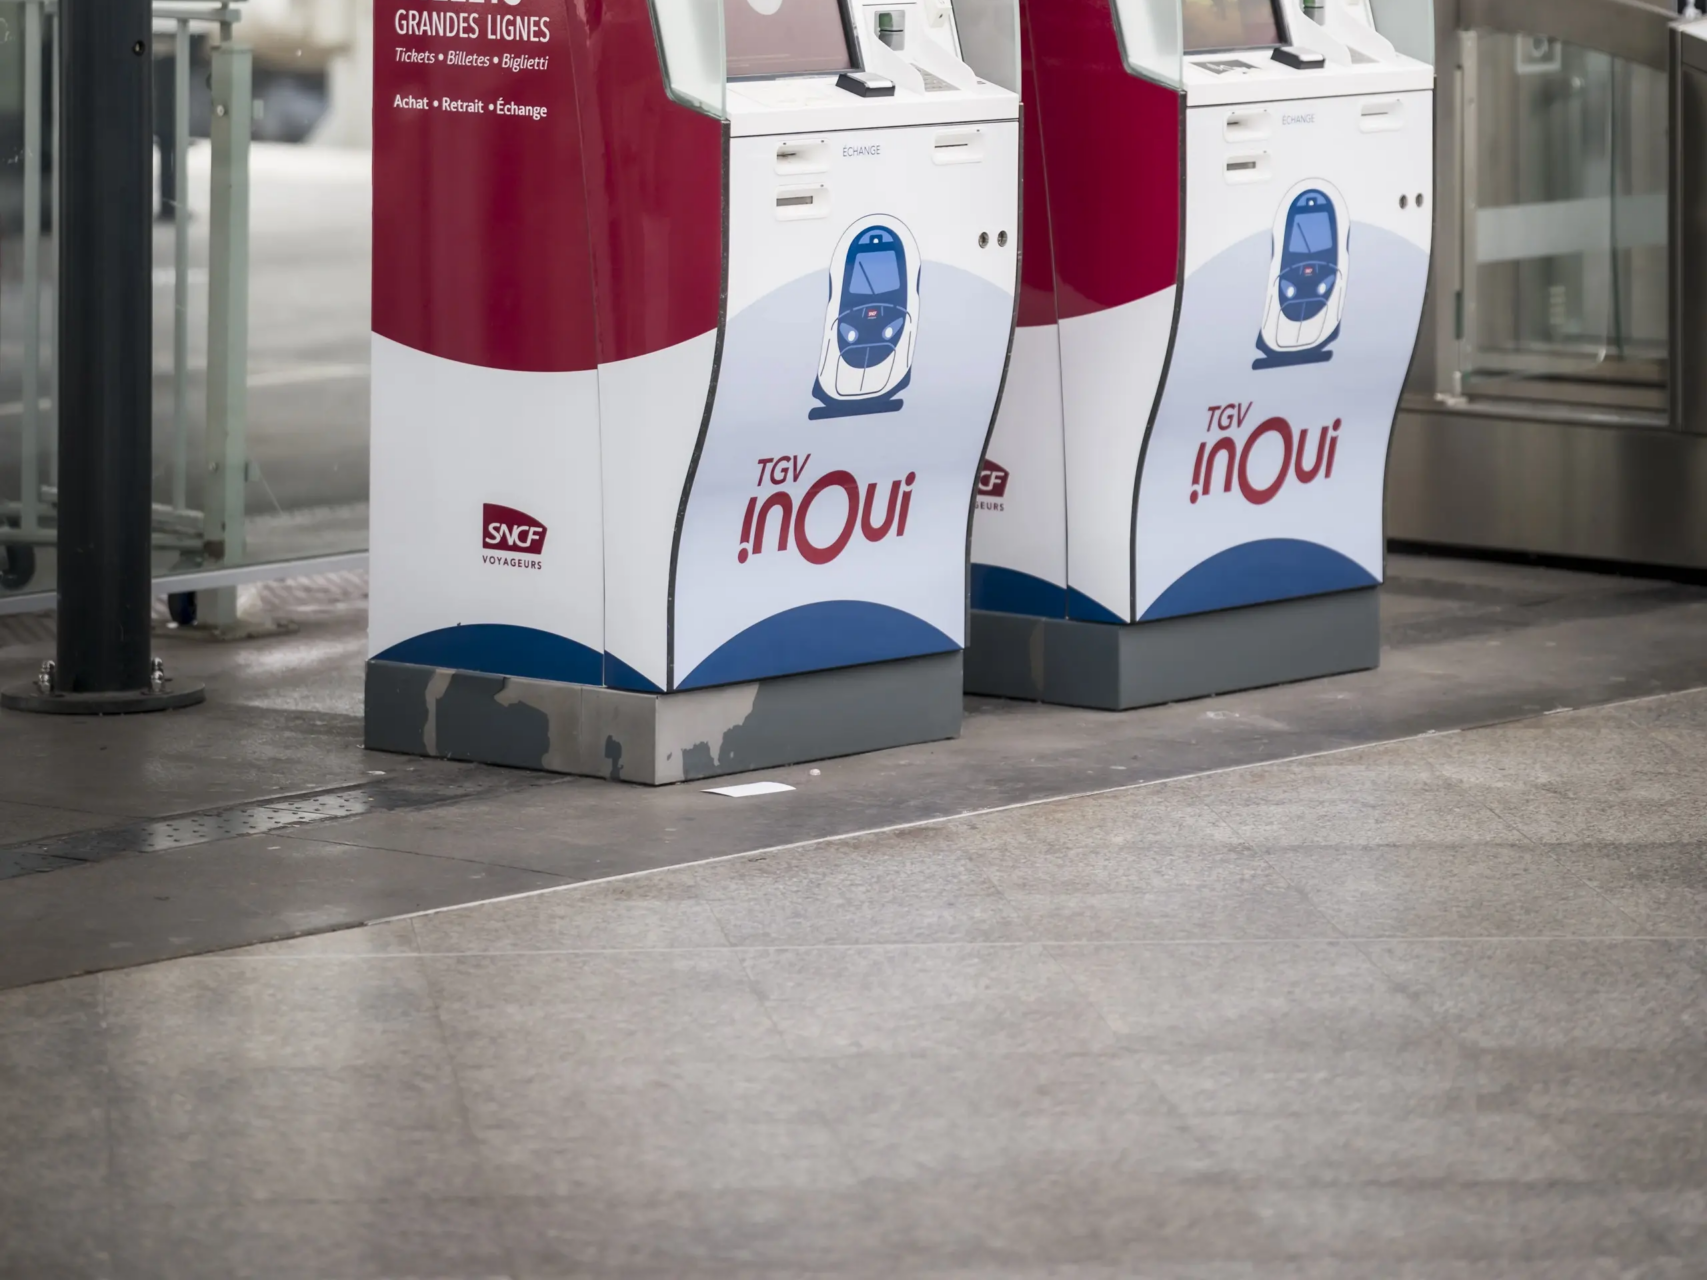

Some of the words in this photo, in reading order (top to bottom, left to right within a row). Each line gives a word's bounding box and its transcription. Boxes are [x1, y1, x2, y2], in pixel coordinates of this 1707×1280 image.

[395, 9, 479, 39] GRANDES
[488, 14, 550, 43] LIGNES
[395, 47, 435, 63] Tickets
[447, 51, 490, 67] Billetes
[502, 54, 549, 72] Biglietti
[394, 94, 429, 110] Achat
[442, 97, 484, 113] Retrait
[497, 98, 547, 120] Échange
[1282, 114, 1315, 125] ÉCHANGE
[842, 145, 881, 158] ÉCHANGE
[1206, 401, 1253, 432] TGV
[757, 453, 811, 487] TGV
[979, 470, 1005, 491] CF
[485, 522, 543, 547] SNCF
[482, 555, 542, 570] VOYAGEURS
